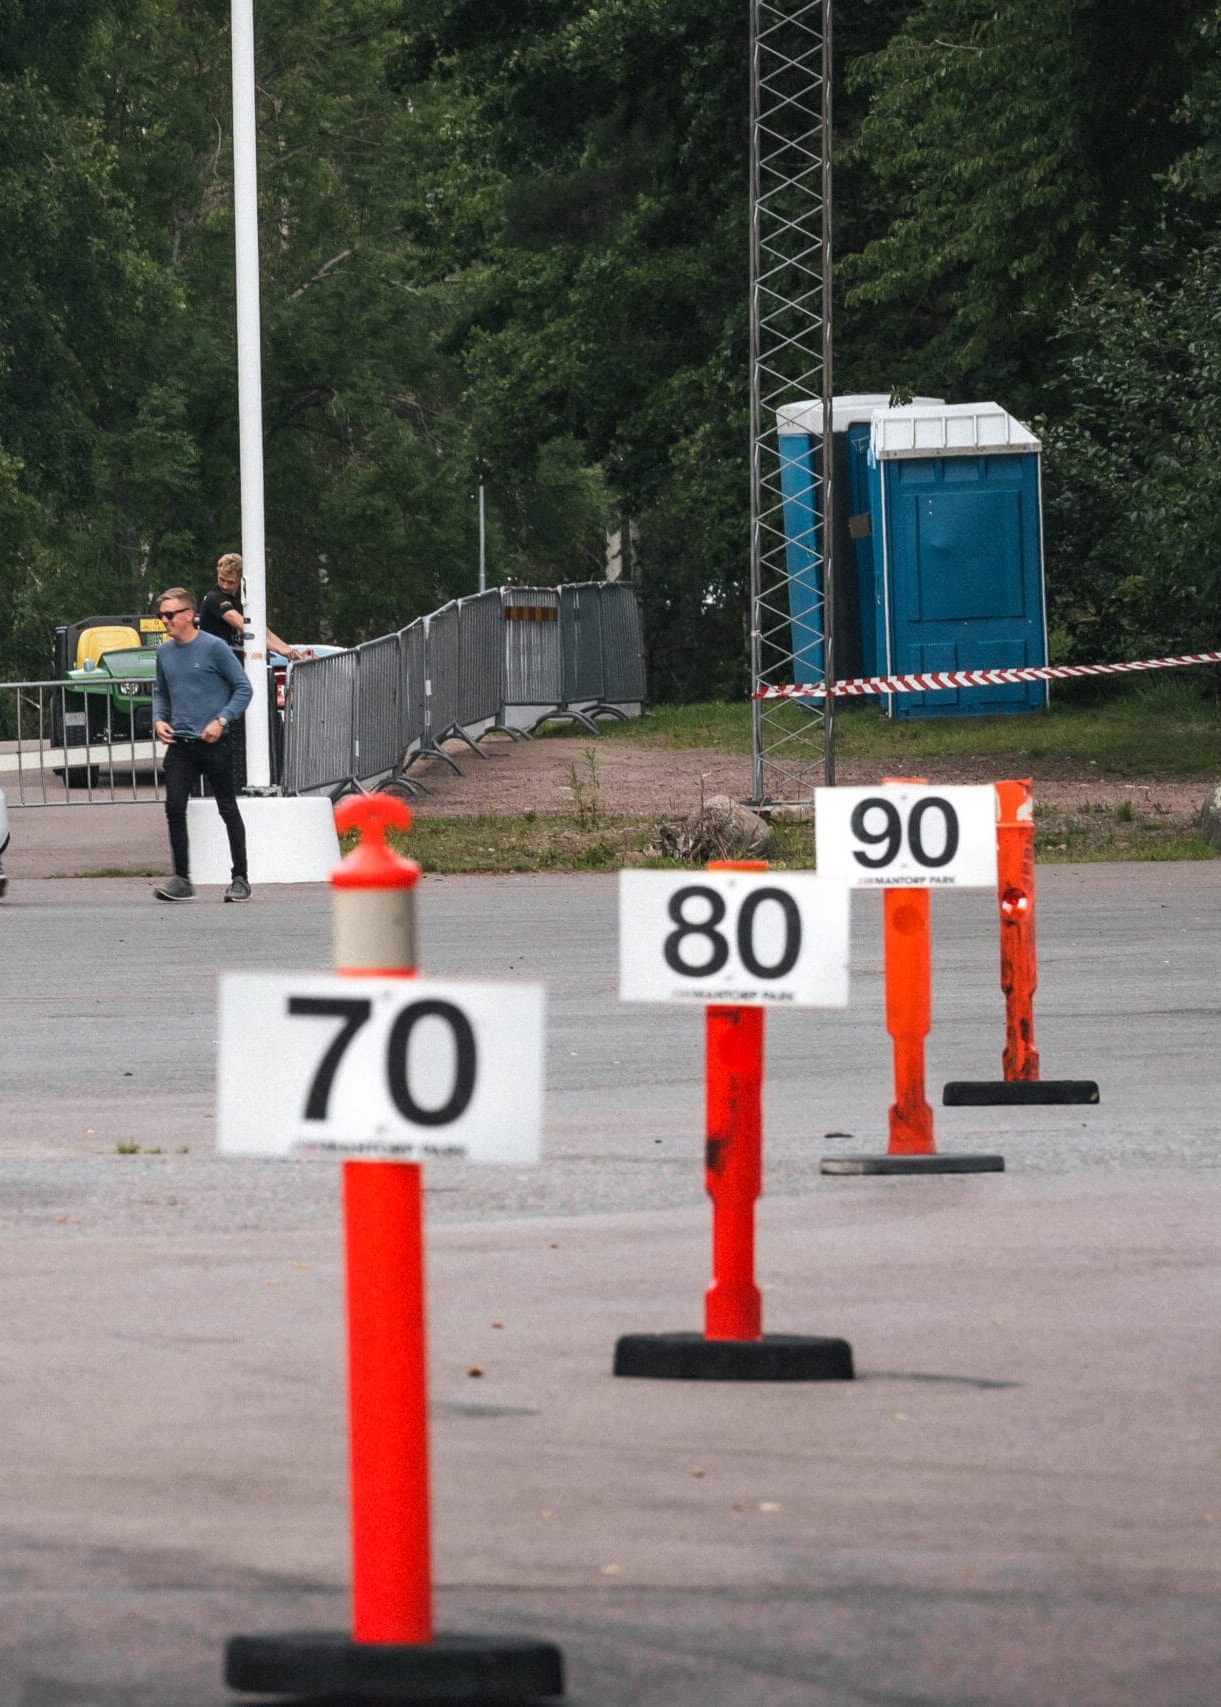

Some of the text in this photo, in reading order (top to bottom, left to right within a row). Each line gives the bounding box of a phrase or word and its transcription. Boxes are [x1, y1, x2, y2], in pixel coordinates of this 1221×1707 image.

[850, 797, 959, 868] 90
[664, 885, 801, 979] 80
[288, 996, 476, 1127] 70
